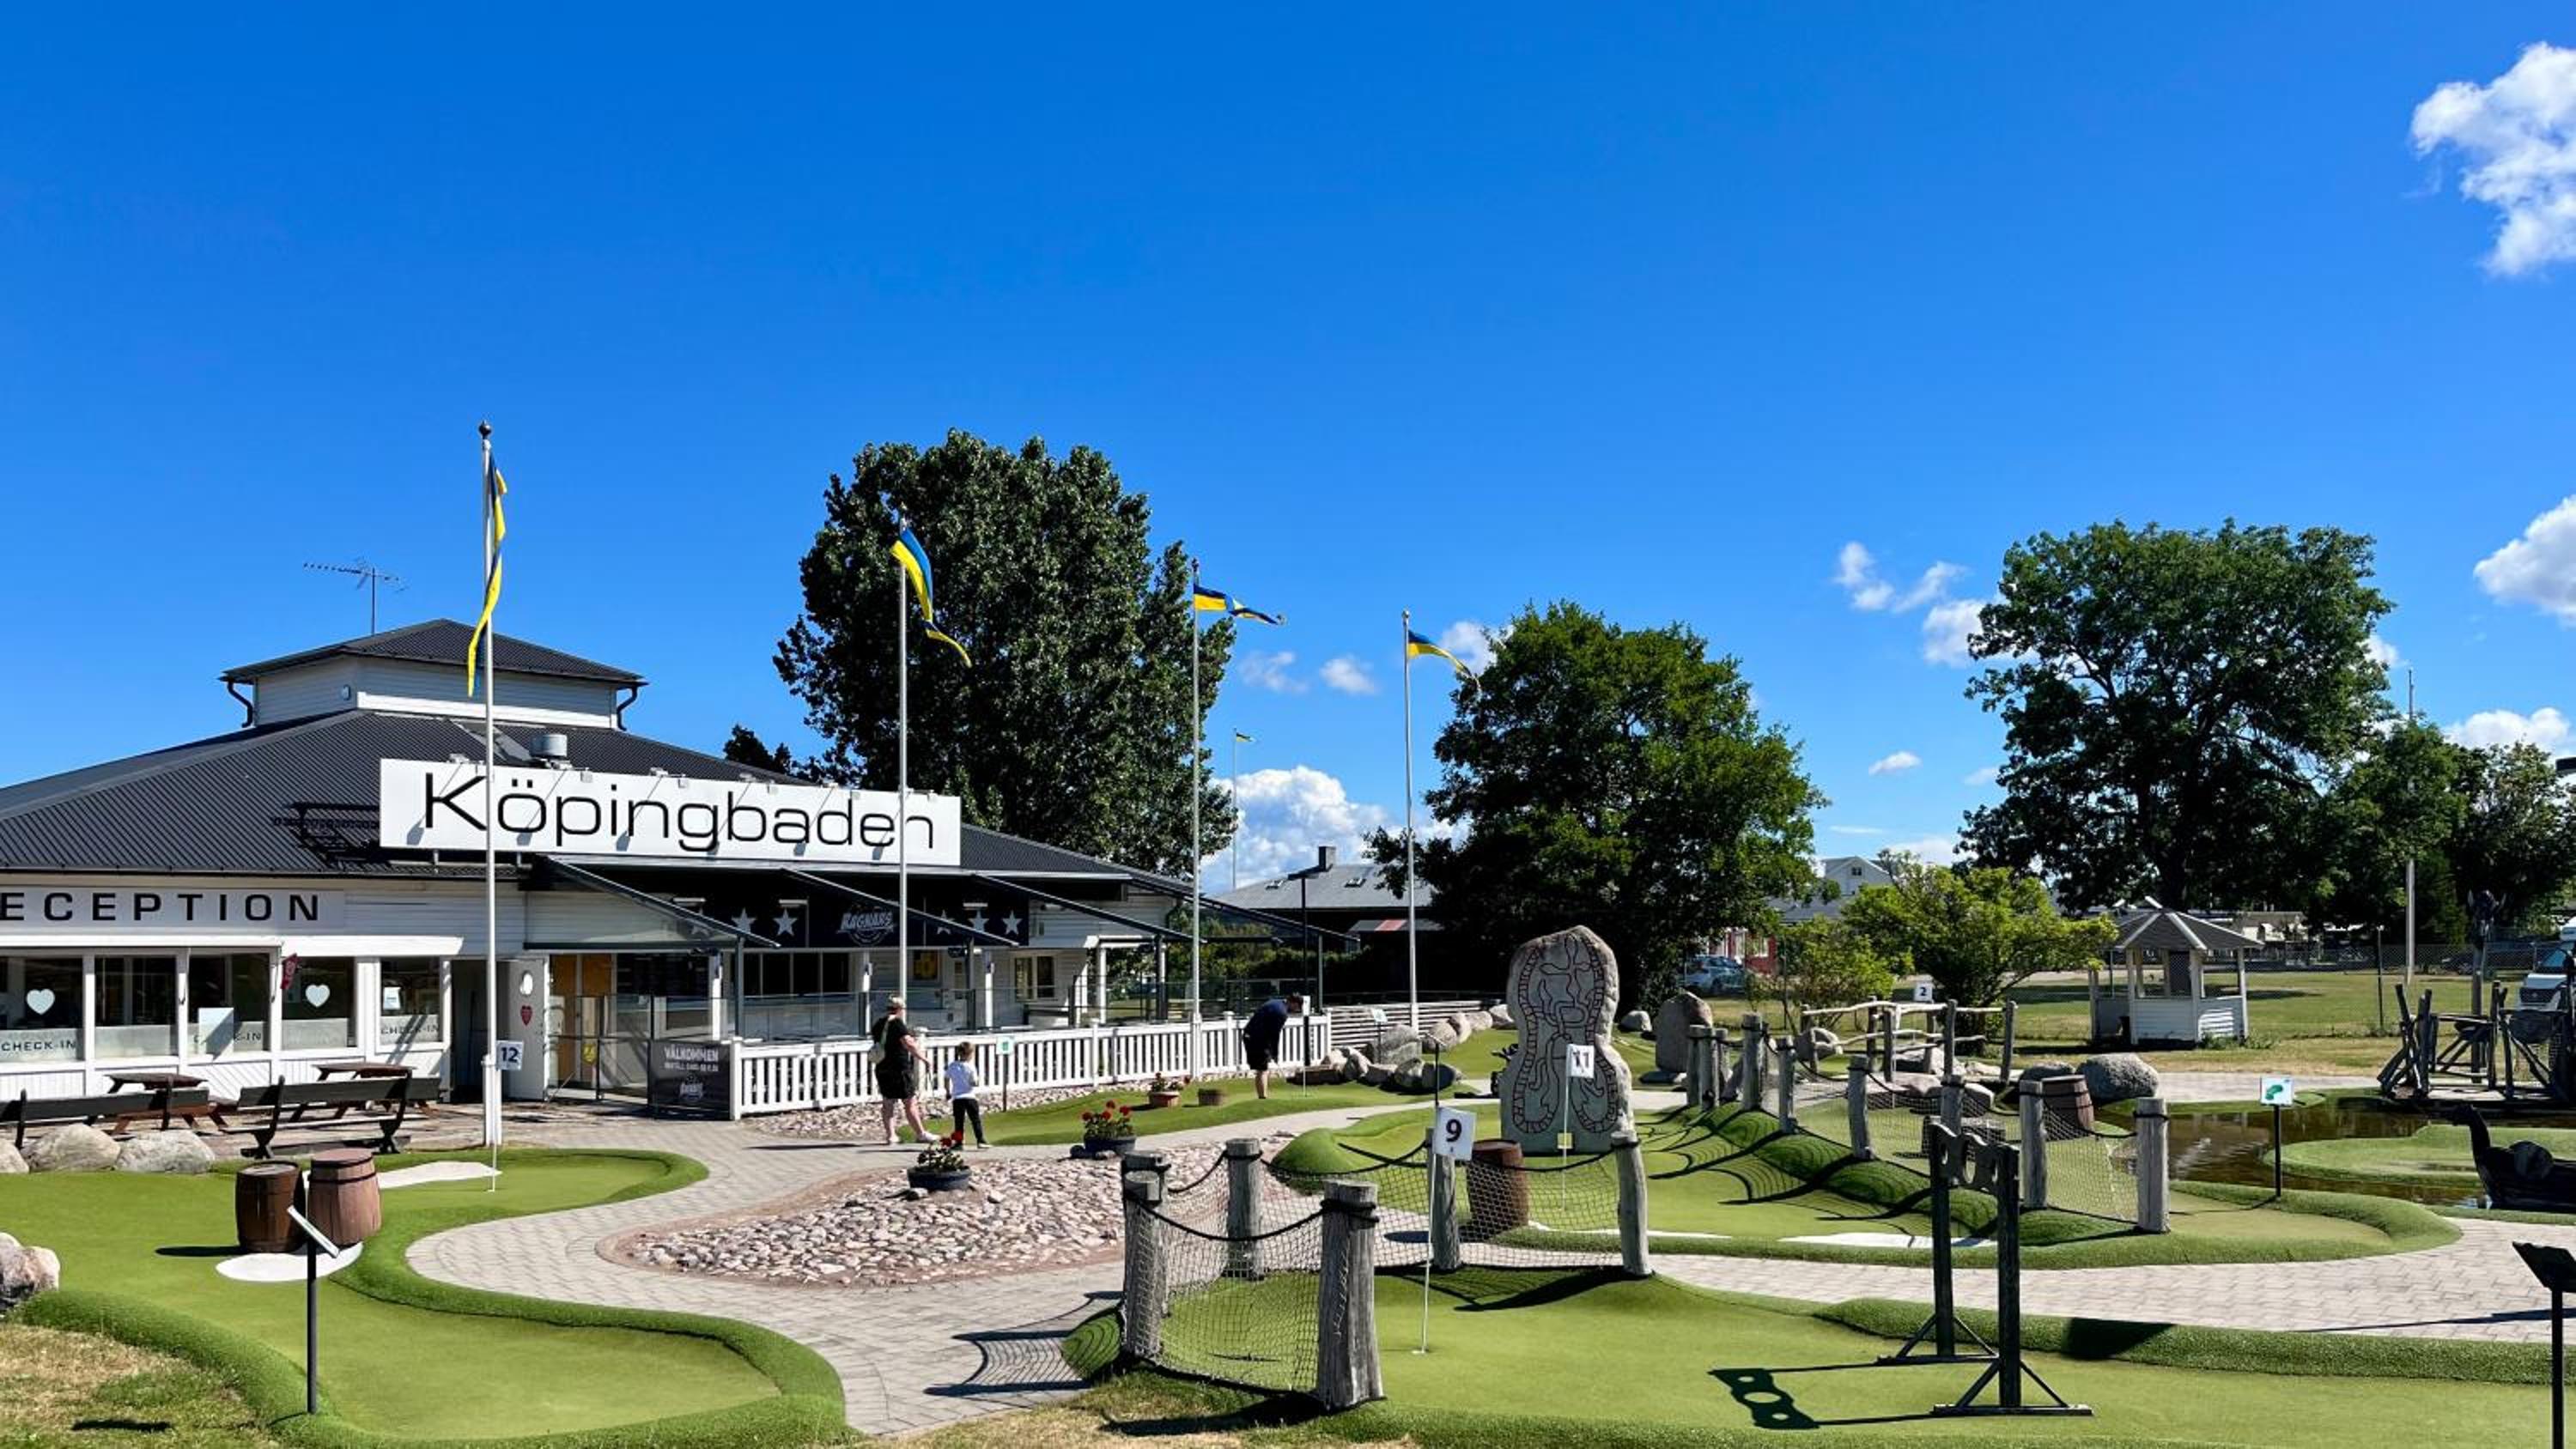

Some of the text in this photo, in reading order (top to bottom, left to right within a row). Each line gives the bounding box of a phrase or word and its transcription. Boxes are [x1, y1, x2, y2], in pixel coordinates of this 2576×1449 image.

[426, 772, 933, 852] Köpingbaden
[1920, 986, 1927, 997] 2
[1, 1040, 76, 1052] CHECK-IN
[501, 1046, 519, 1064] 12
[1572, 1050, 1589, 1069] 11
[1445, 1119, 1462, 1143] 9
